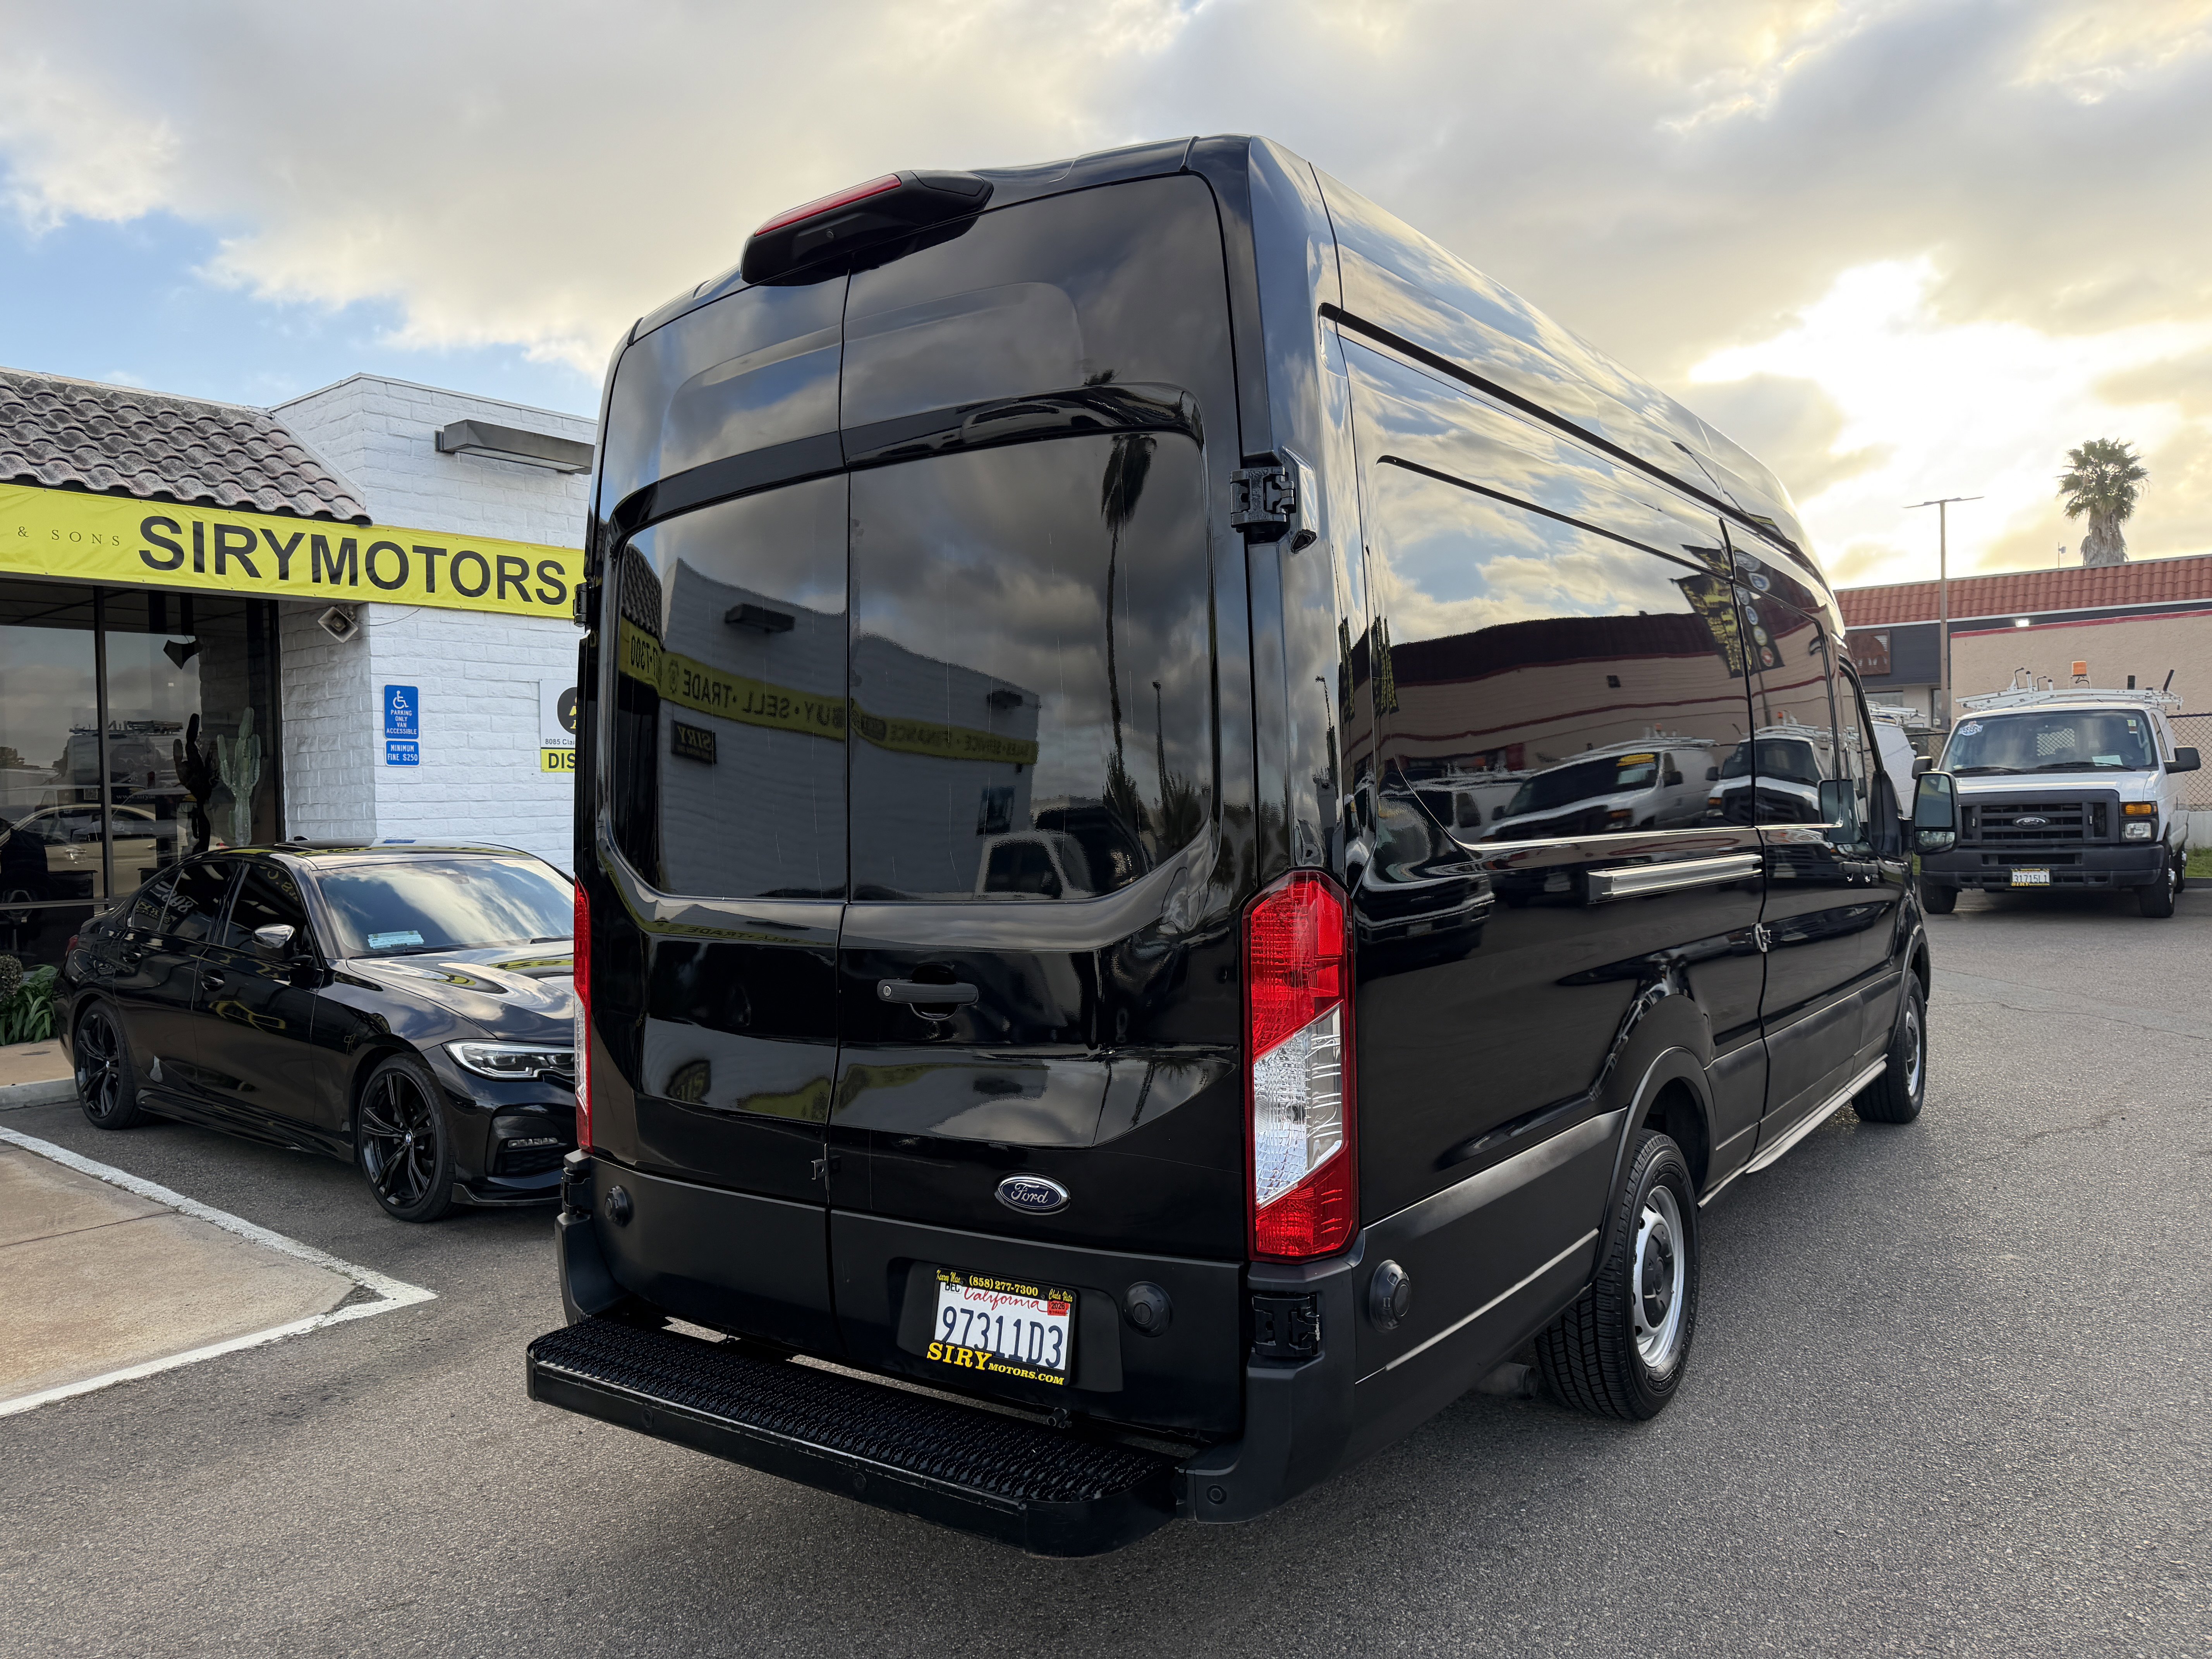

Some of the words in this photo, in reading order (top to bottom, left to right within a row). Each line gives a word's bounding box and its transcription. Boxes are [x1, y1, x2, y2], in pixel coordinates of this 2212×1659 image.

[18, 526, 29, 538] &
[52, 529, 120, 547] SONS
[139, 516, 567, 606] SIRYMOTORS
[390, 744, 414, 752] MINIMUM
[403, 753, 418, 761] $250
[548, 752, 575, 769] DIS
[1011, 1182, 1049, 1204] Ford
[945, 1283, 960, 1293] DEC
[969, 1275, 994, 1290] (858)
[994, 1280, 1039, 1297] 277-7300
[964, 1286, 1048, 1313] California
[942, 1305, 1063, 1368] 97311D3
